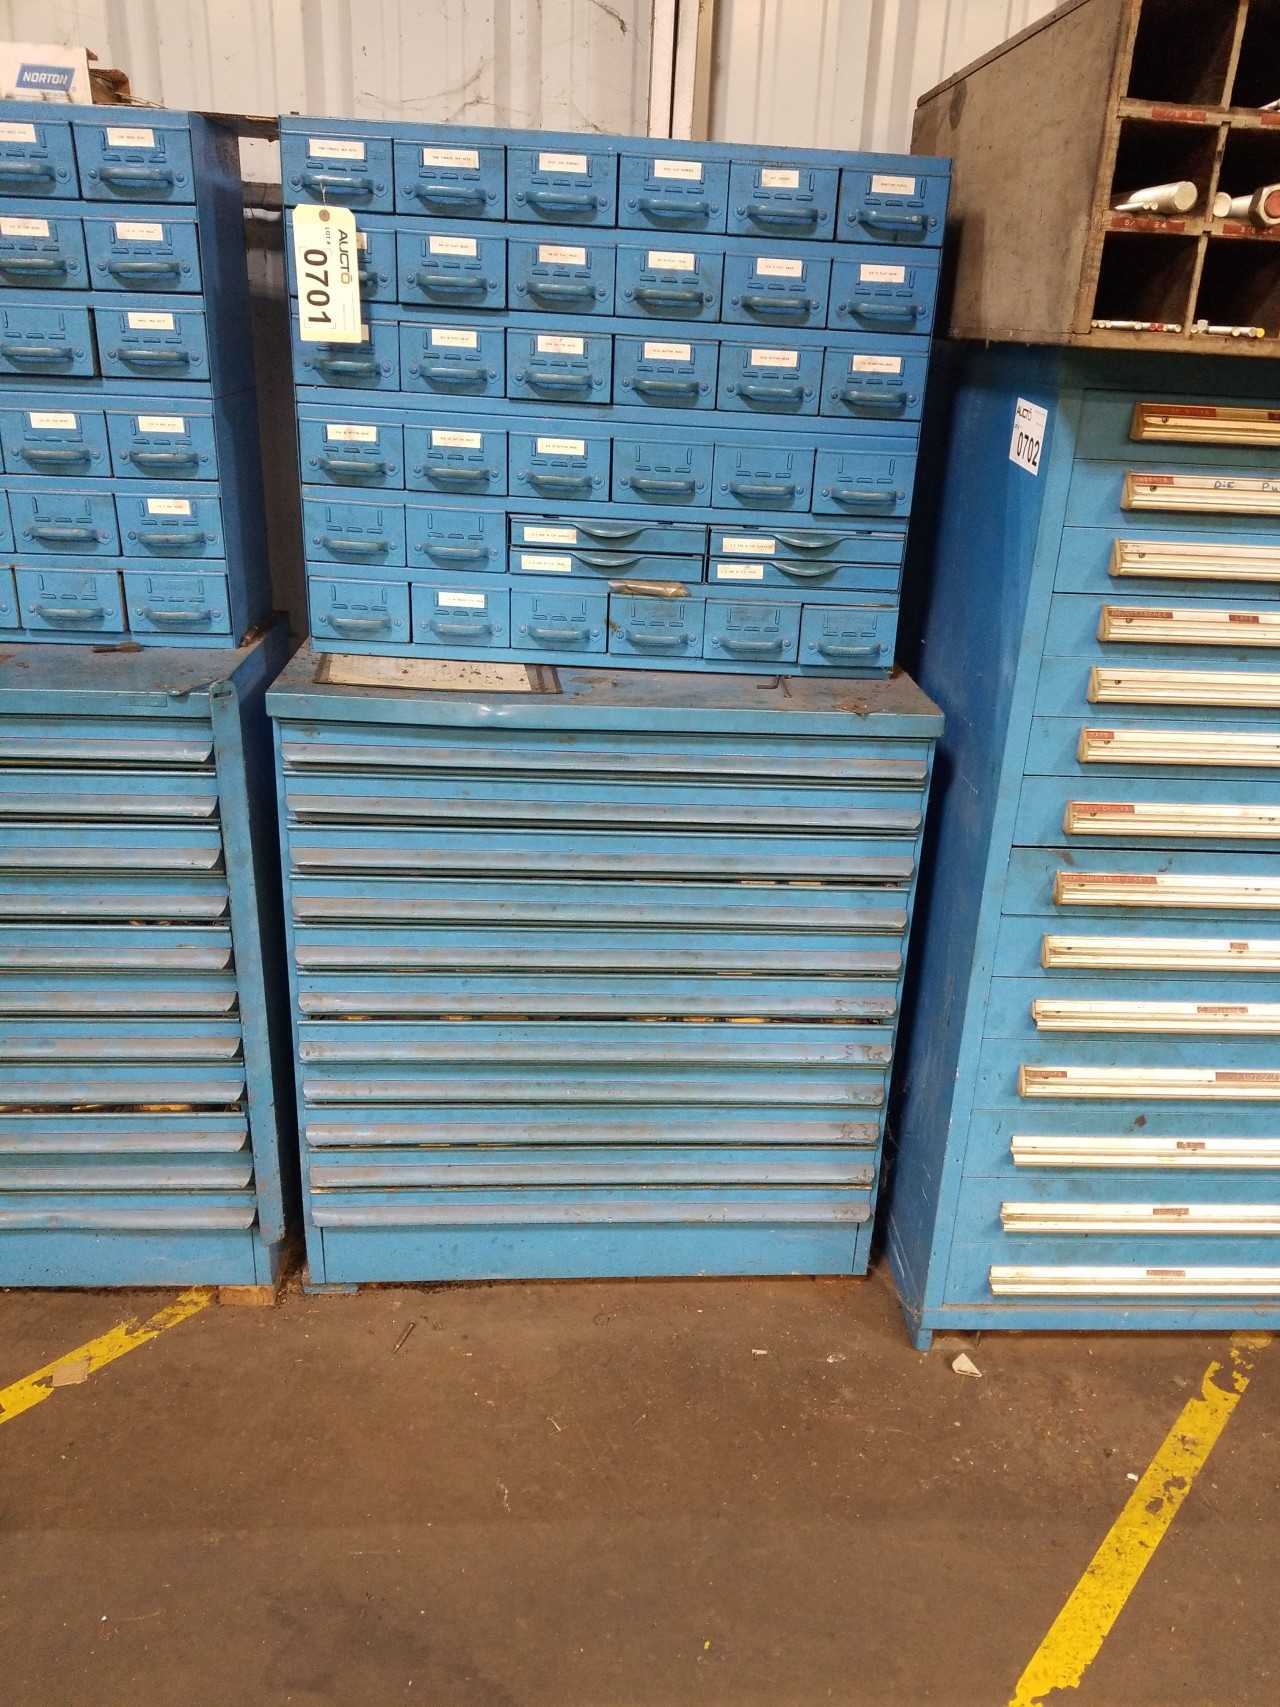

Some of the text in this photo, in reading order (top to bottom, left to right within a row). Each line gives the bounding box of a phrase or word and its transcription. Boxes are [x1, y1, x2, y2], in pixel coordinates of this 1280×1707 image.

[22, 71, 68, 85] NORTON
[303, 248, 332, 324] 0701
[1016, 431, 1040, 467] 0702
